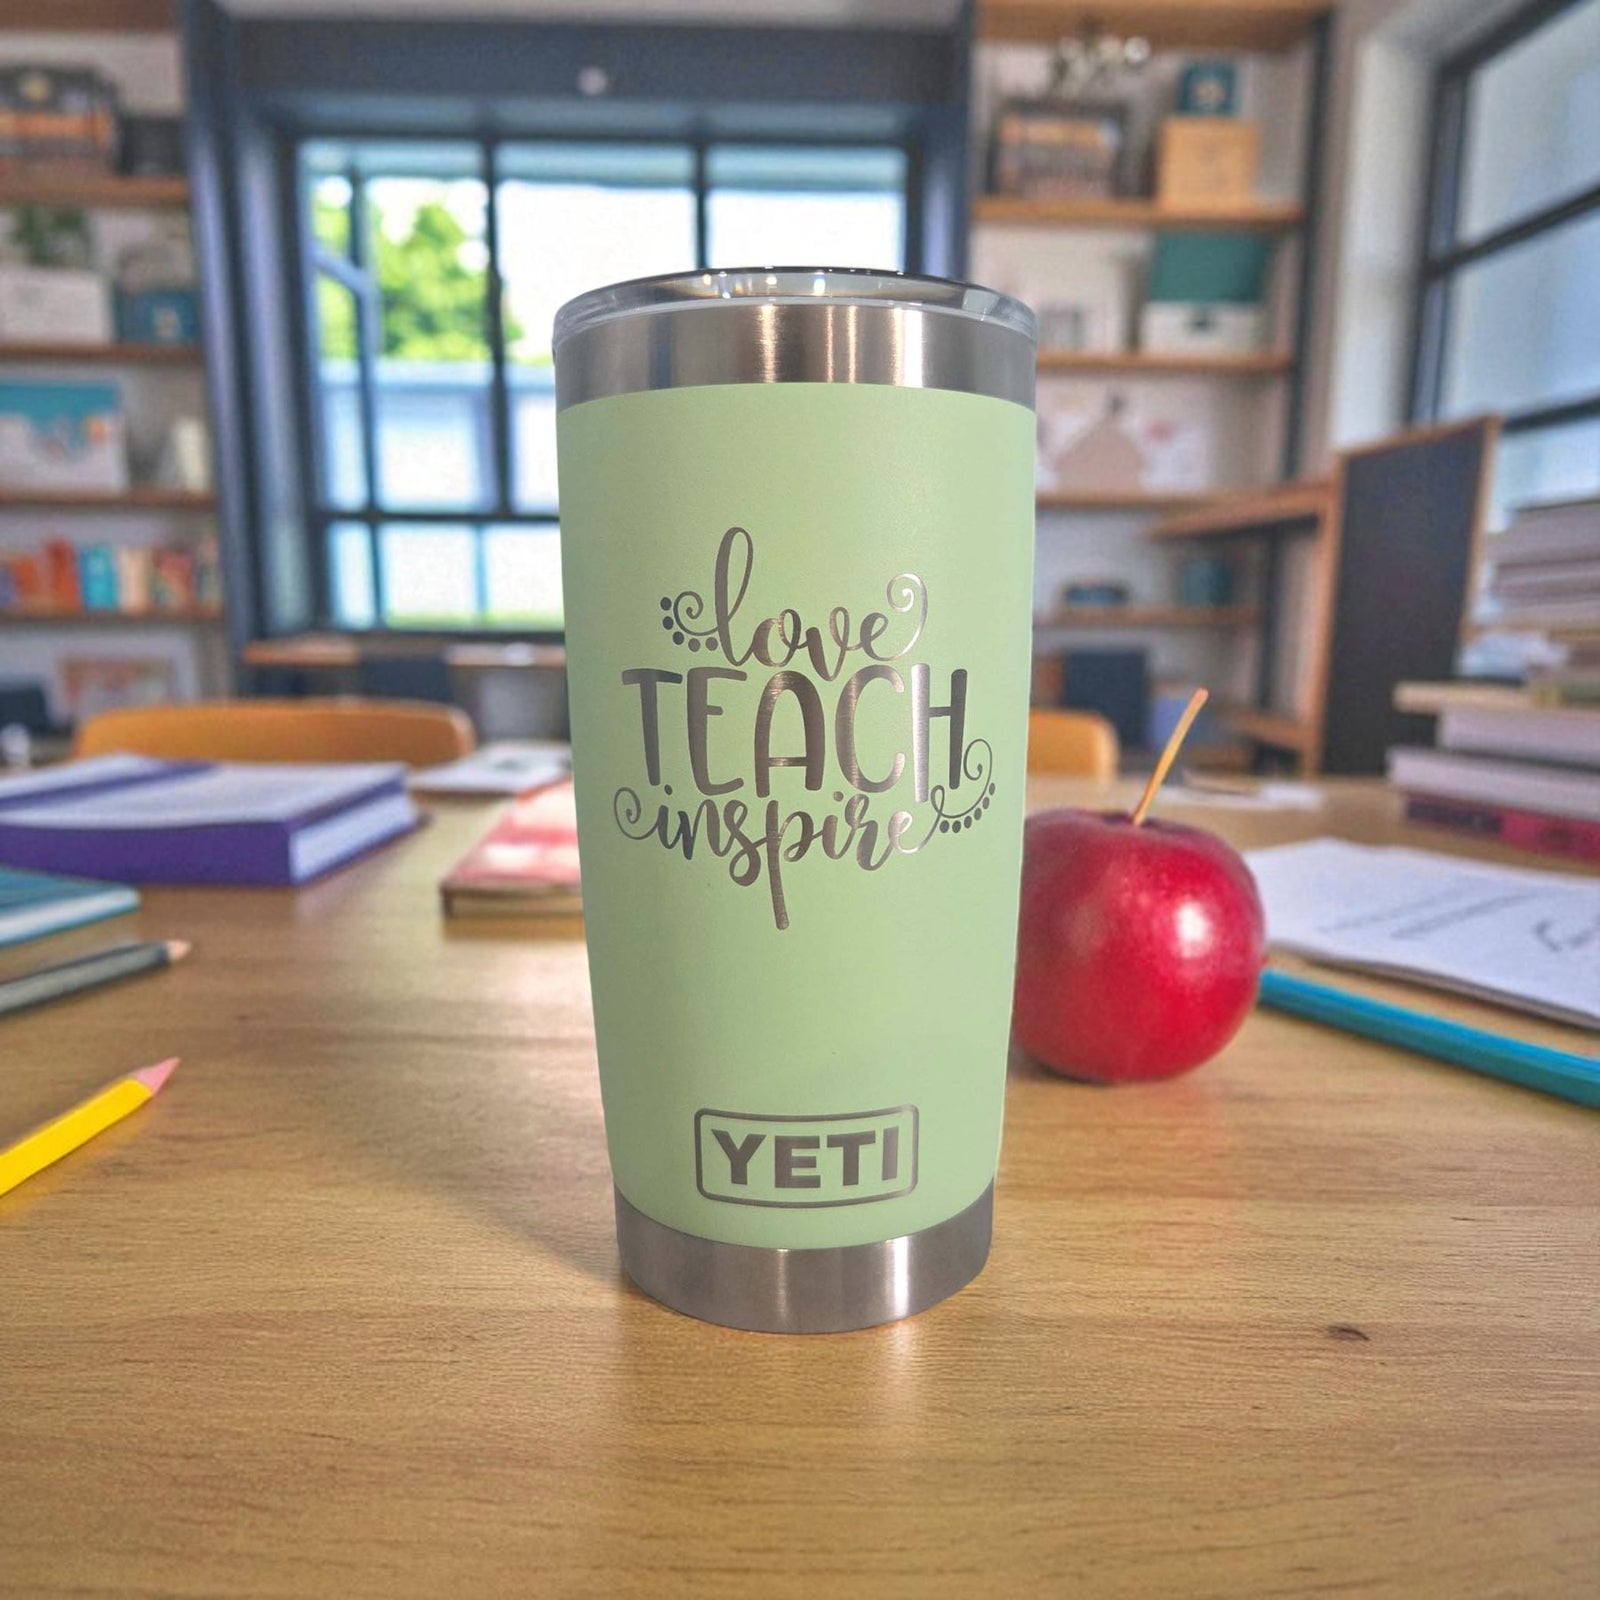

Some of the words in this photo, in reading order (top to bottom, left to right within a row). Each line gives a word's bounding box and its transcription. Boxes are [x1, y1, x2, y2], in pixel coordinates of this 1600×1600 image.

[673, 527, 928, 681] love
[621, 663, 968, 803] TEACH
[614, 784, 992, 930] inspire
[710, 1126, 899, 1189] YETI
